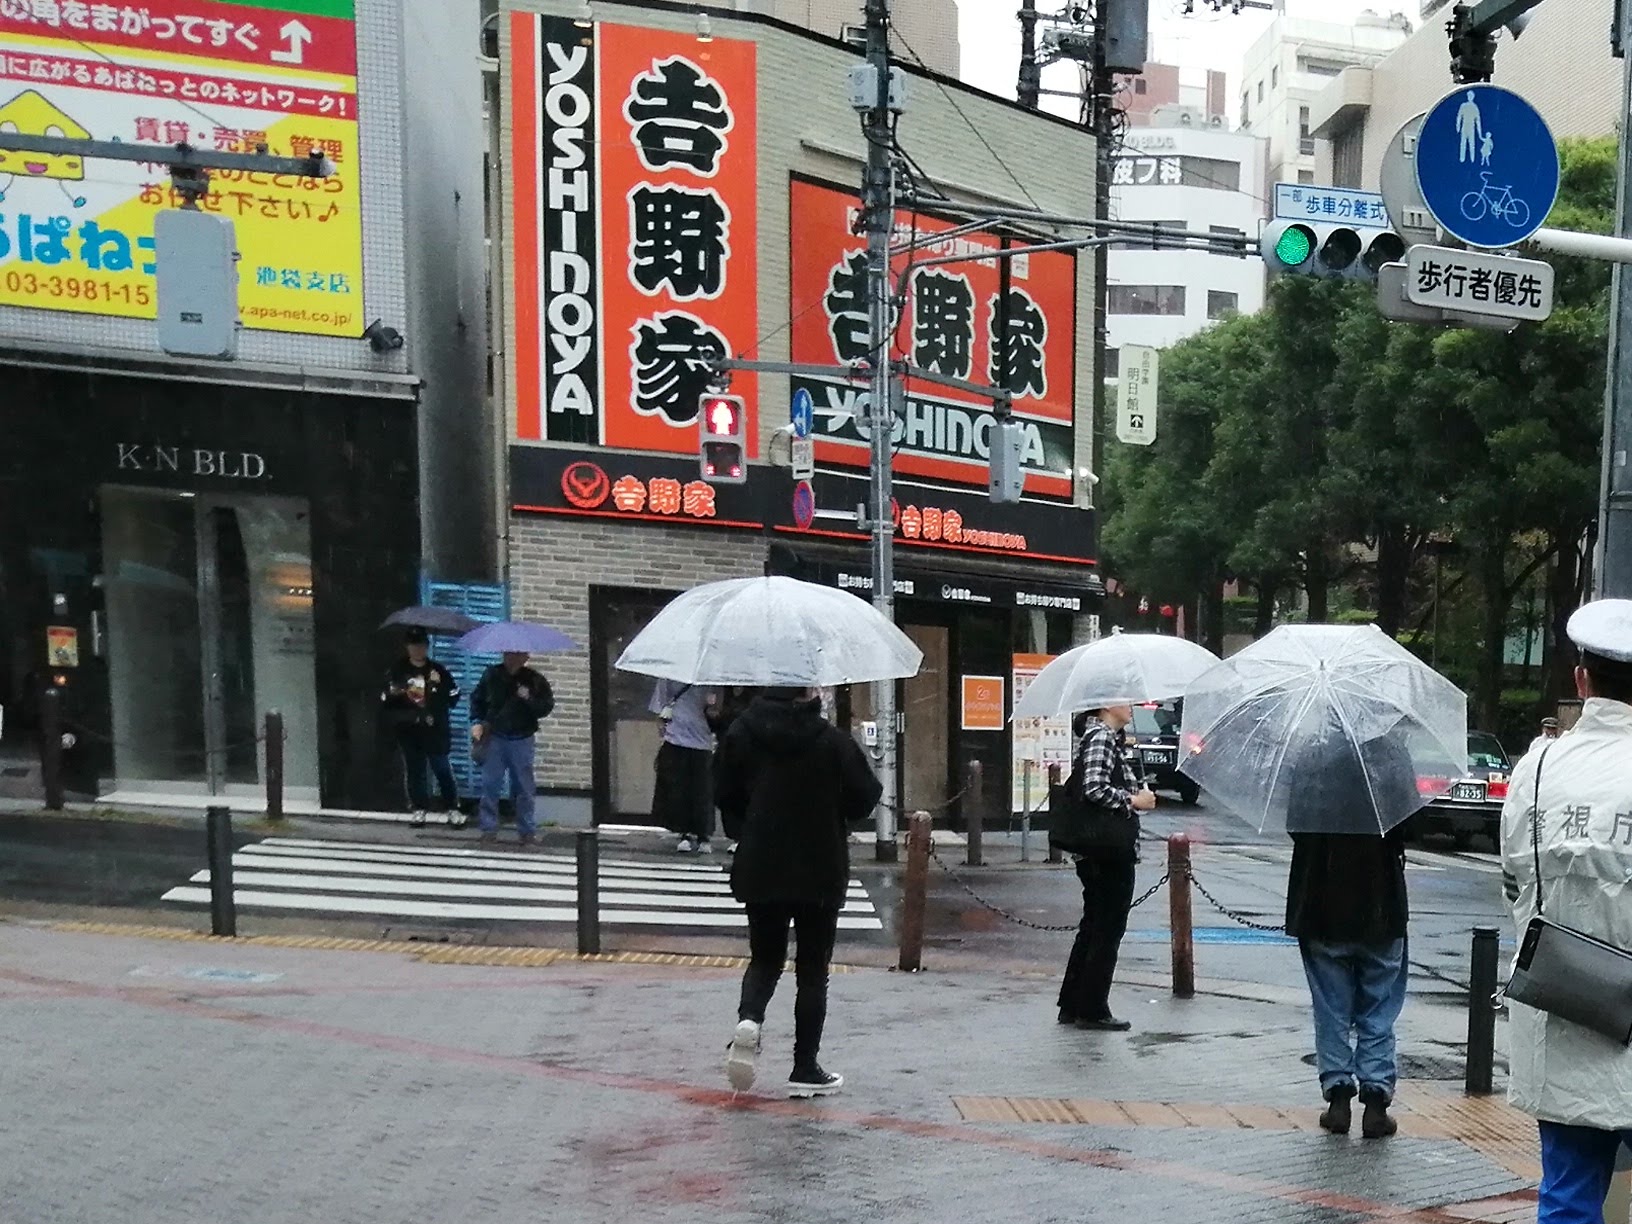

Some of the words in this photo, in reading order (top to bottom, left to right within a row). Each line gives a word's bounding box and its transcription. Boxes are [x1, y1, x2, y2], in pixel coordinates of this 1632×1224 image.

[545, 42, 594, 415] YOSHINOYA
[1306, 195, 1386, 221] 歩車分離式
[622, 54, 735, 428] 吉野家
[1418, 260, 1543, 309] 歩行者優先
[822, 248, 1047, 399] 吉野家
[611, 474, 717, 518] 吉野家
[901, 504, 963, 543] 吉野家
